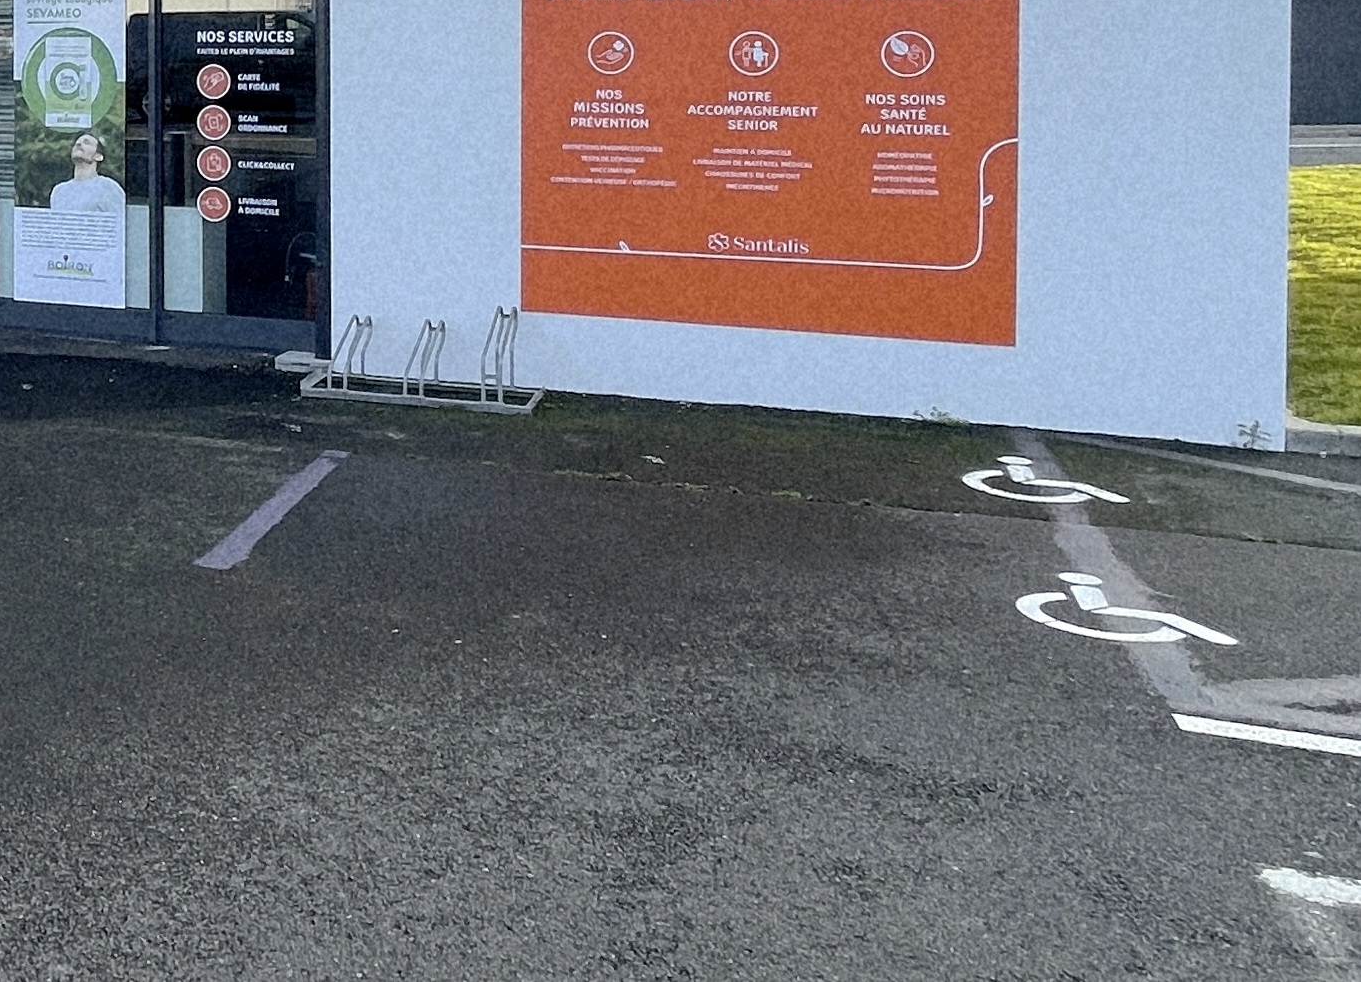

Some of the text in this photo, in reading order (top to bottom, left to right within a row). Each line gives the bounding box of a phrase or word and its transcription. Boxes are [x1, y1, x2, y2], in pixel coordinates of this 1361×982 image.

[196, 30, 295, 43] NOS SERVICES
[237, 73, 261, 82] CARTE
[596, 89, 623, 99] NOS
[728, 91, 772, 102] NOTRE
[865, 94, 946, 106] NOS SOINS
[573, 101, 645, 115] MISSIONS
[687, 104, 818, 117] ACCOMPAGNEMENT
[880, 107, 927, 120] SANTÉ
[570, 115, 650, 129] PRÉVENTION
[727, 119, 778, 131] SENIOR
[861, 123, 950, 136] AU NATUREL
[237, 160, 296, 171] CLICK&COLLECT
[733, 236, 810, 254] Santalis
